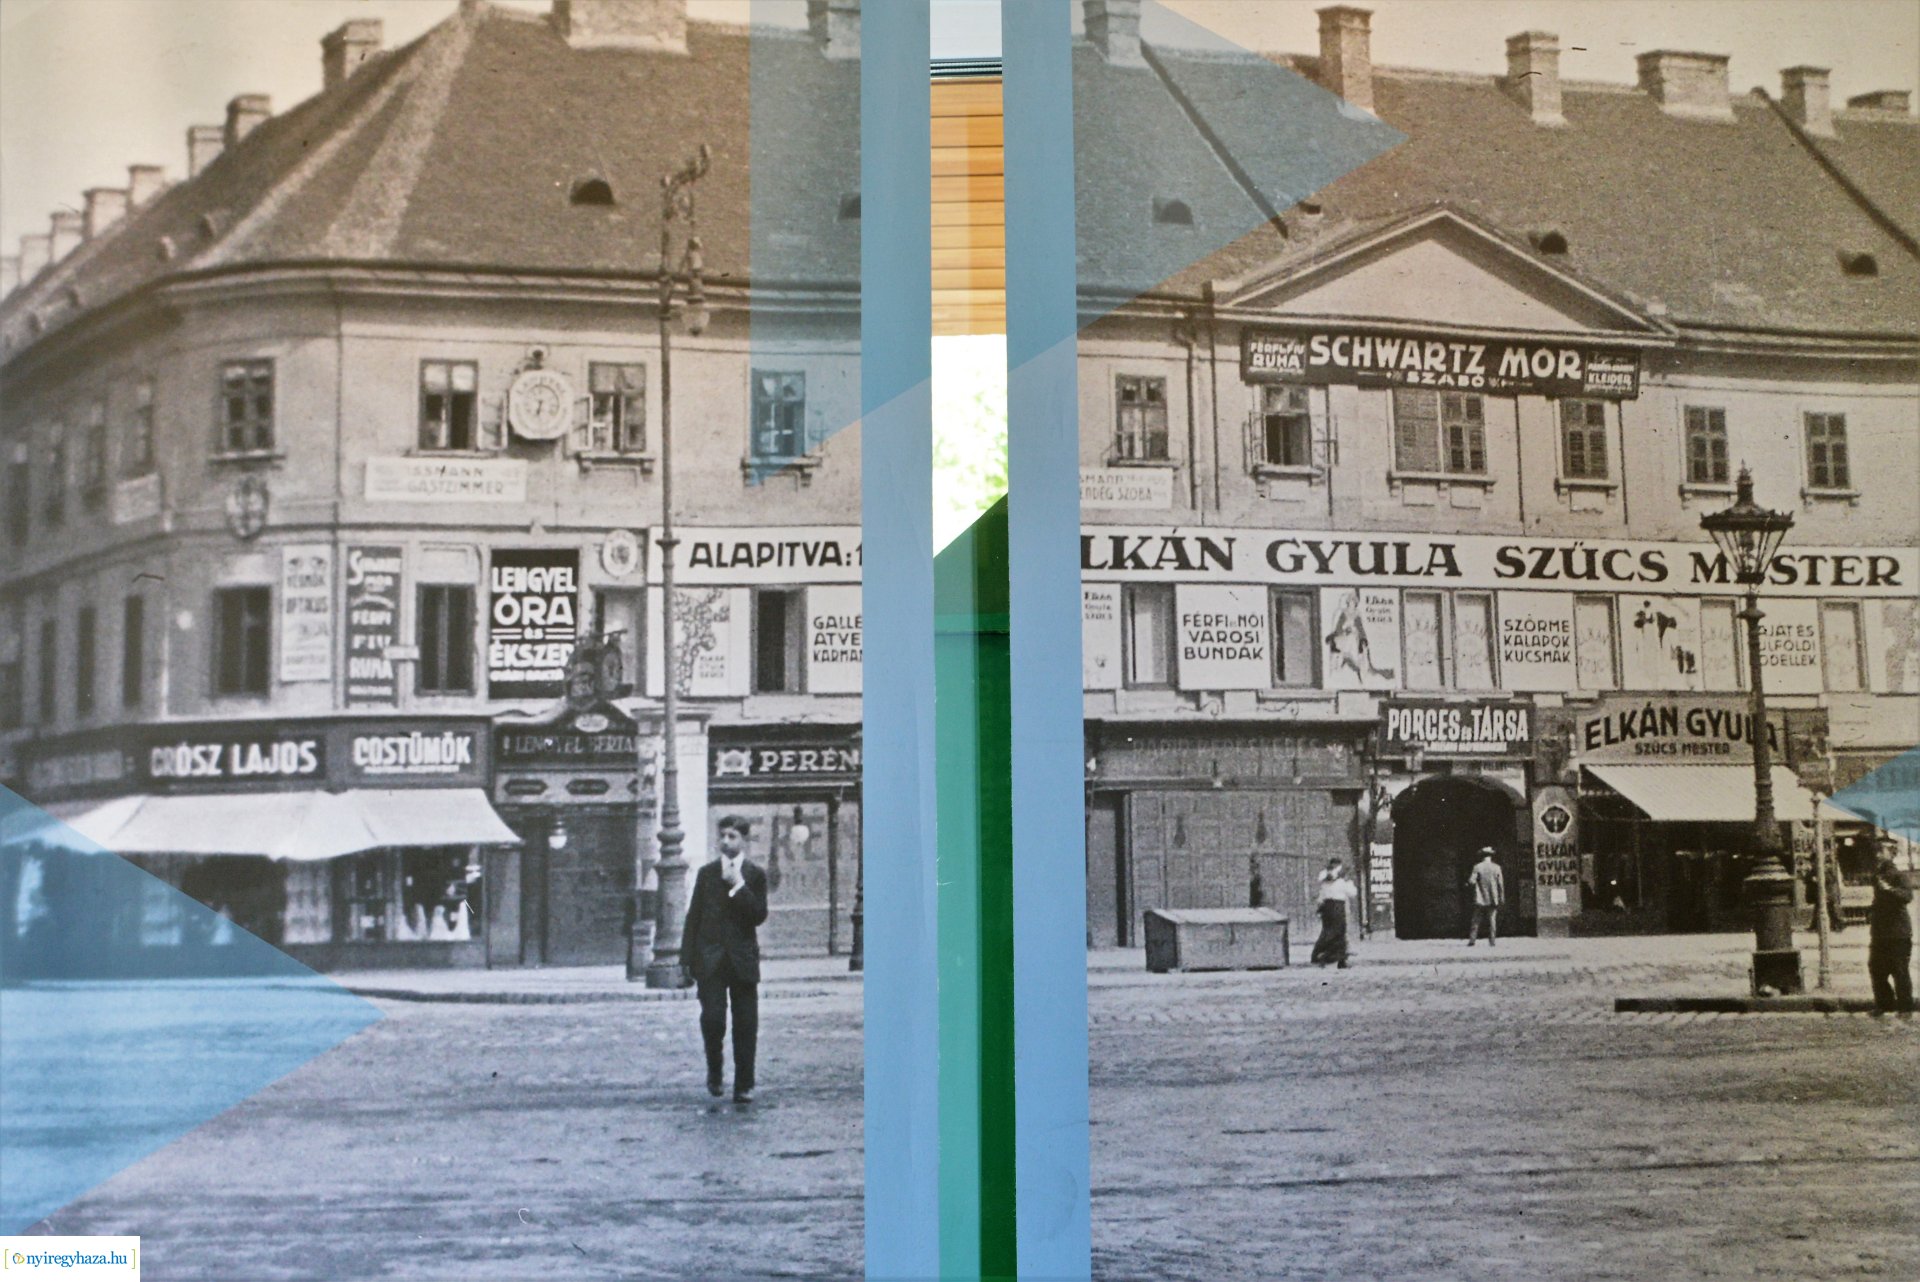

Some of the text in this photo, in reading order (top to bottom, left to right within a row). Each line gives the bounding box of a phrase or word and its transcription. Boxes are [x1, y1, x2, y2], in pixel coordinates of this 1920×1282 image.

[1309, 335, 1582, 380] SCHWARTZ MÓR
[1406, 371, 1485, 388] SZABÓ
[1265, 538, 1463, 577] GYULA
[492, 567, 577, 593] LENGYEL
[493, 592, 574, 626] ÓRA
[1503, 634, 1570, 648] KALAPOK
[1760, 654, 1817, 666] ODELLEK
[1471, 704, 1529, 742] TÁRSA
[1585, 702, 1679, 751] ELKÁN
[231, 740, 318, 775] LAJOS
[1681, 742, 1730, 755] MESTER
